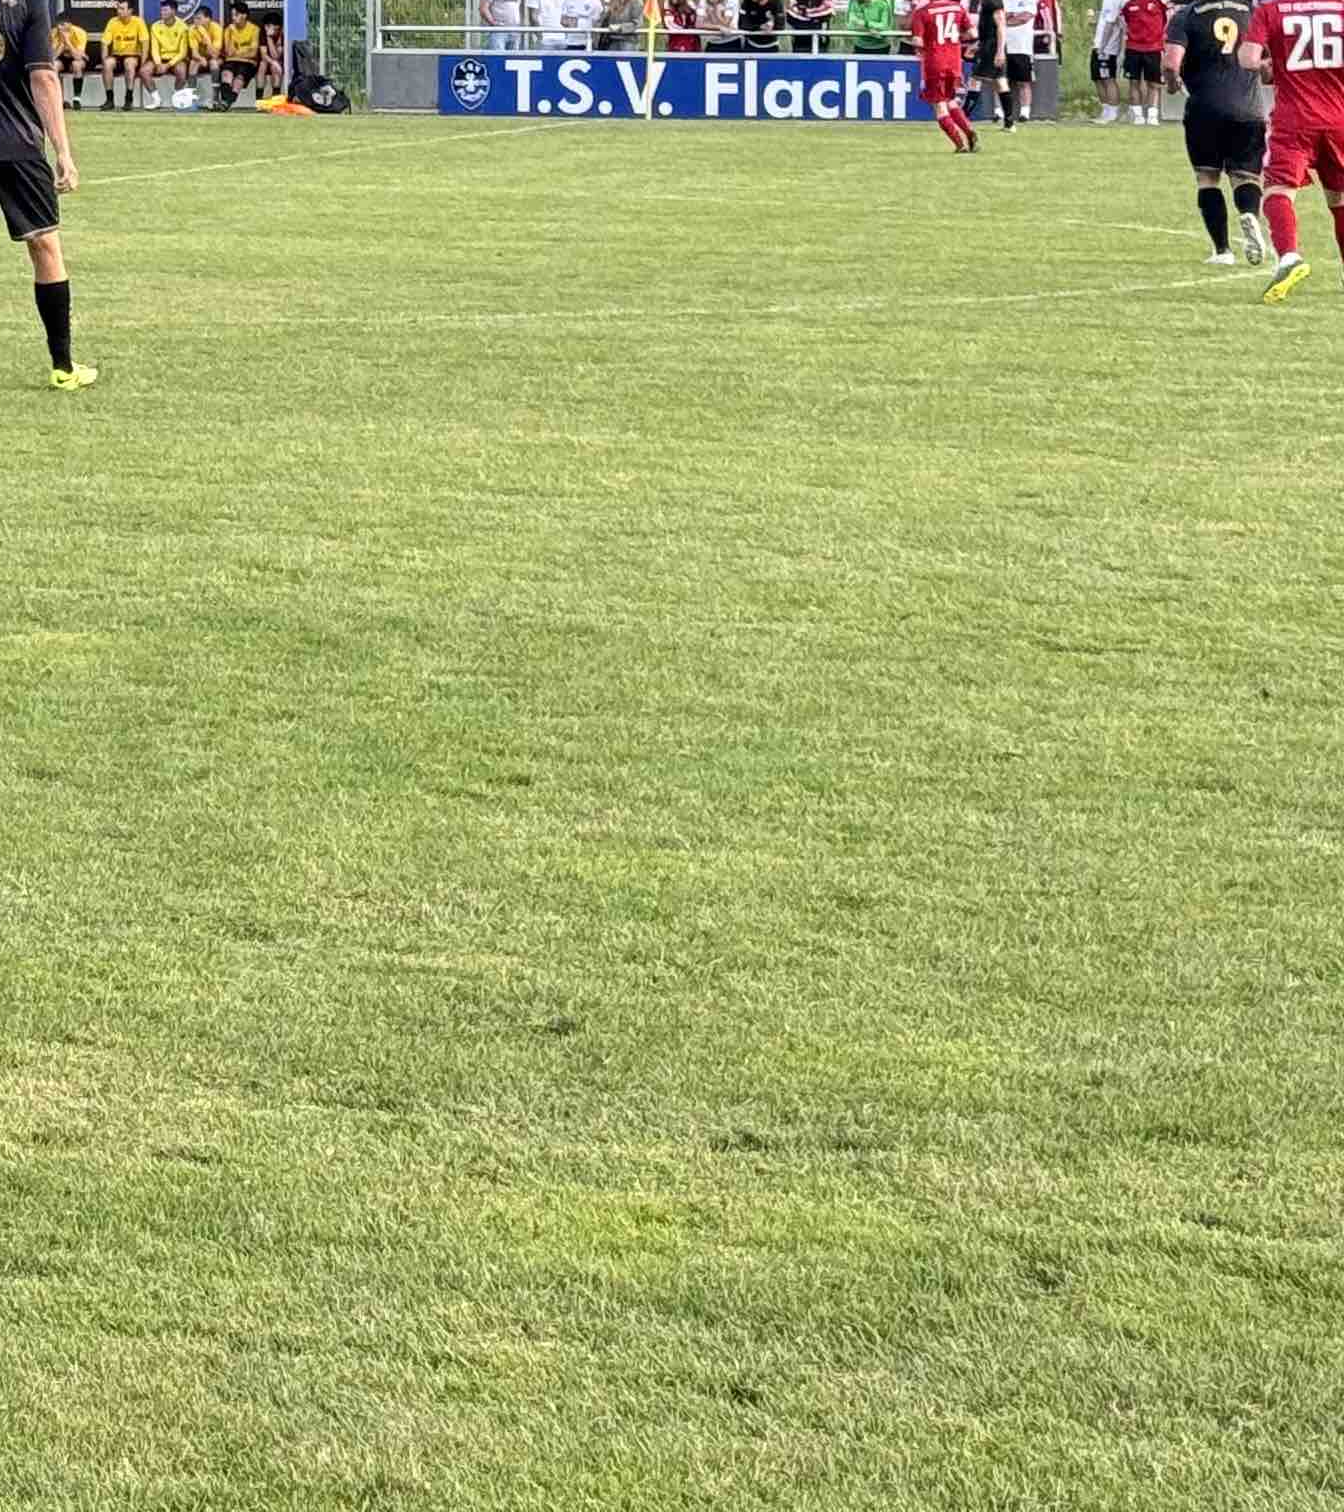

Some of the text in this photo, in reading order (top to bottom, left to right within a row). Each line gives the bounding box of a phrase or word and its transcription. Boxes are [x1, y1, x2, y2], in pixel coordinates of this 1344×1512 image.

[70, 0, 118, 8] teamservic
[935, 13, 959, 45] 14
[1214, 16, 1238, 54] 9
[1282, 14, 1344, 72] 26
[704, 61, 912, 119] Flacht
